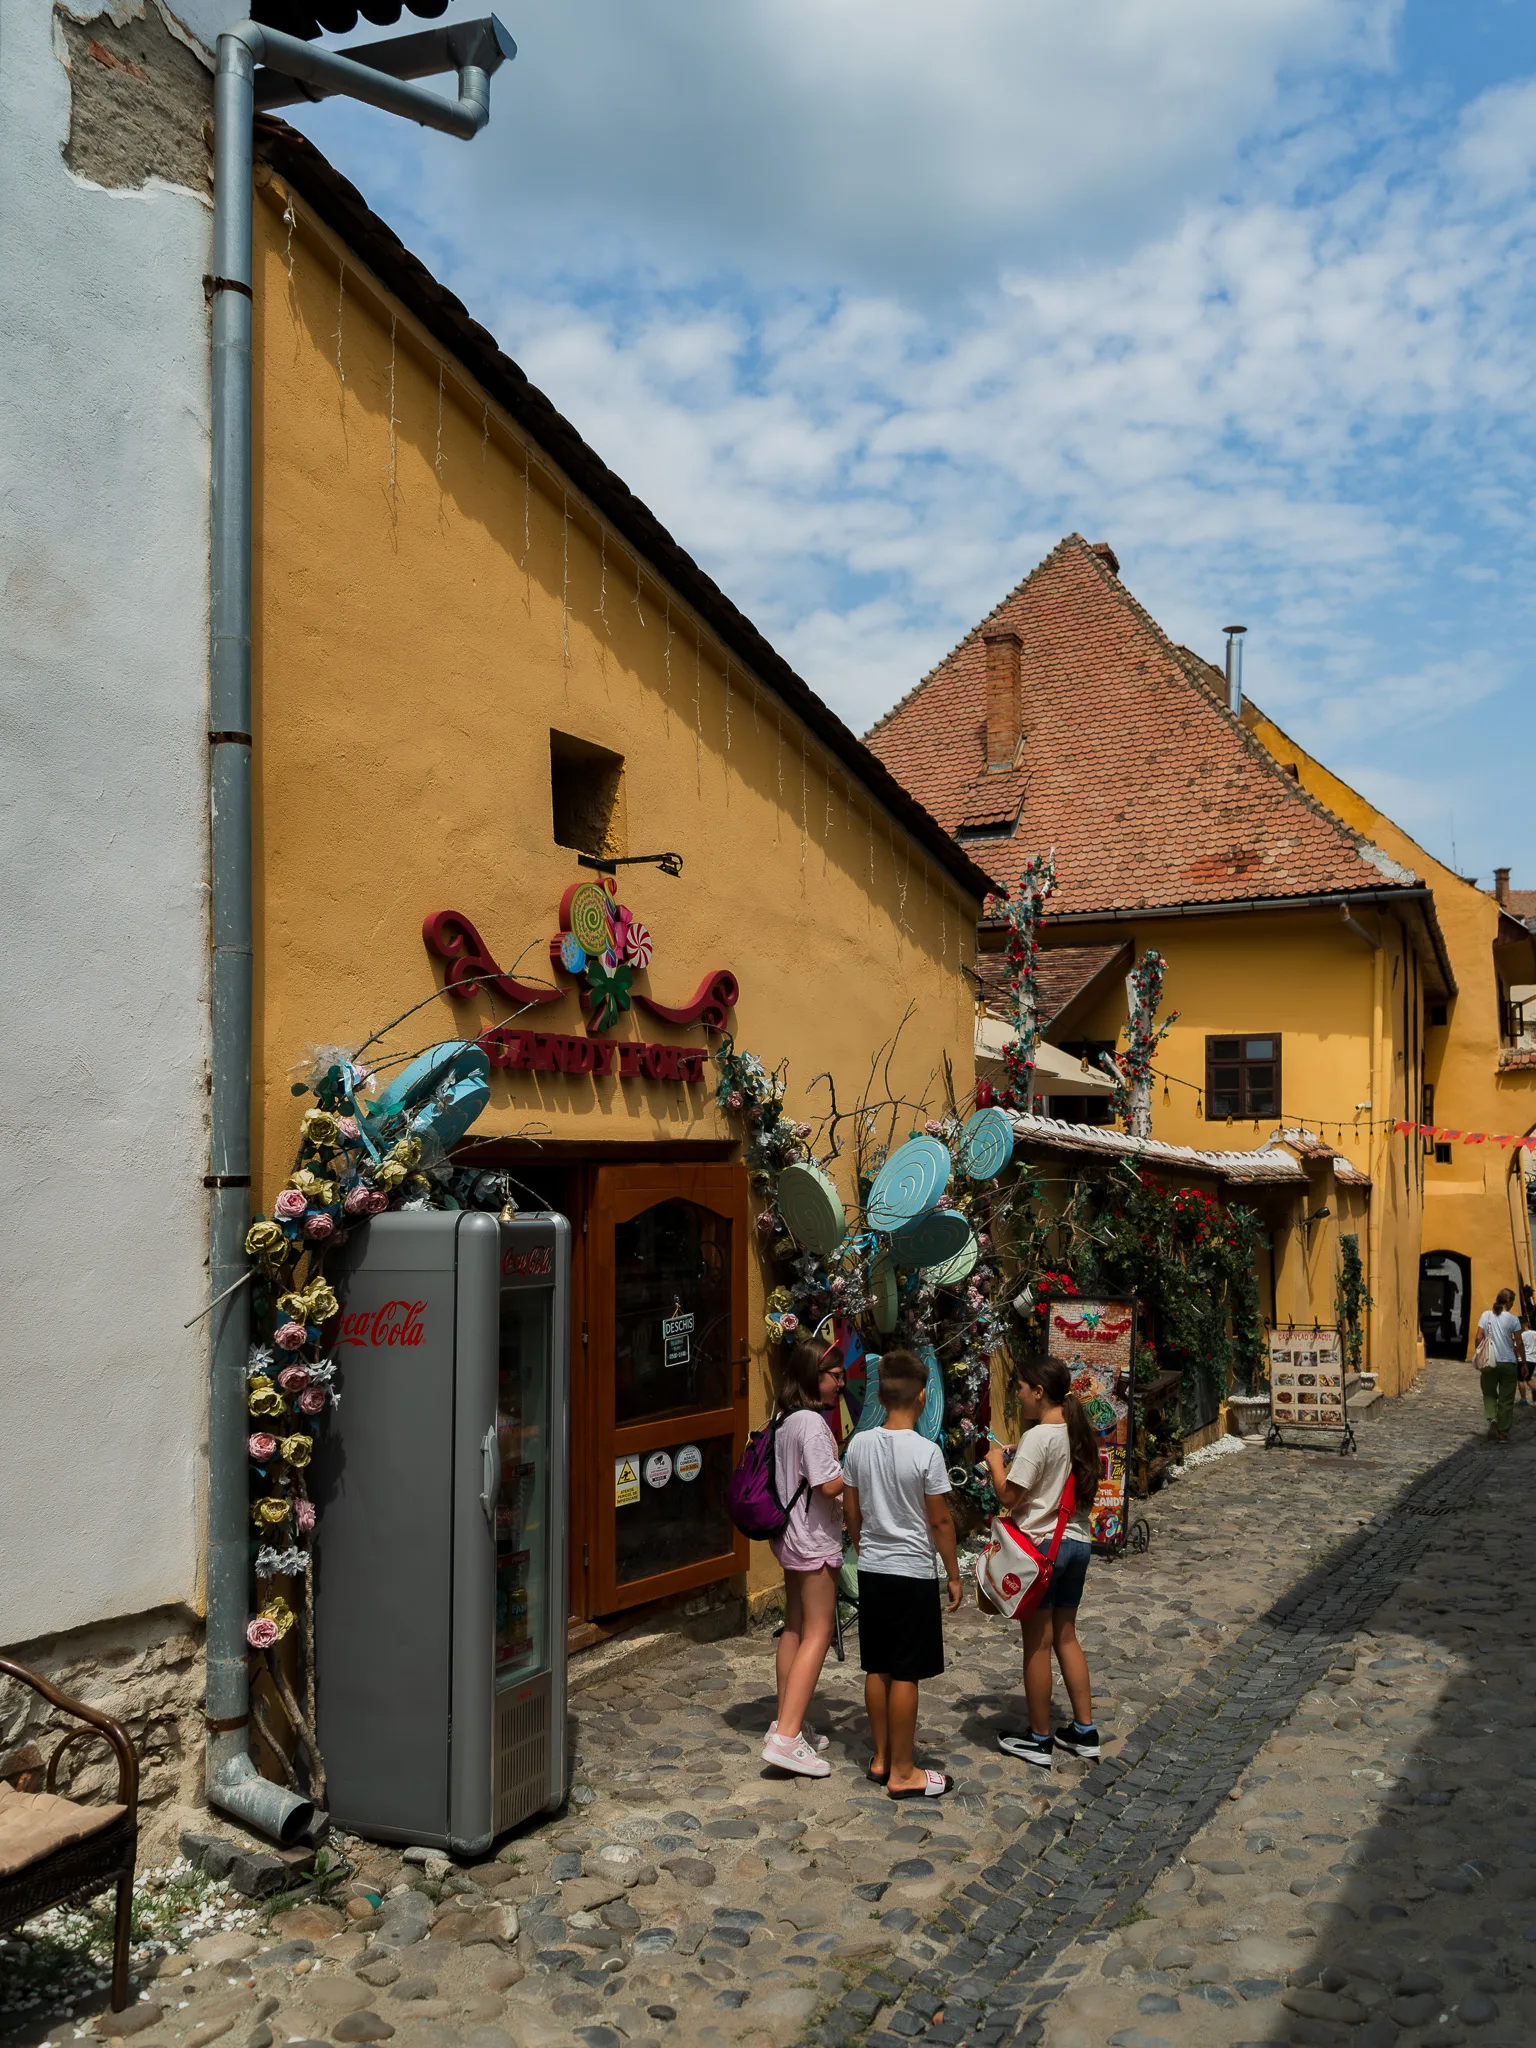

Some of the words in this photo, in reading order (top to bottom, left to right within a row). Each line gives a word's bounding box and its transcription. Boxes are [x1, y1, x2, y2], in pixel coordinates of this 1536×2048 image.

[481, 1026, 617, 1076] CANDY
[618, 1042, 708, 1082] FORT
[501, 1245, 553, 1277] Coca-Cola
[666, 1318, 693, 1335] DESCHIS
[1093, 1496, 1124, 1507] CANDY
